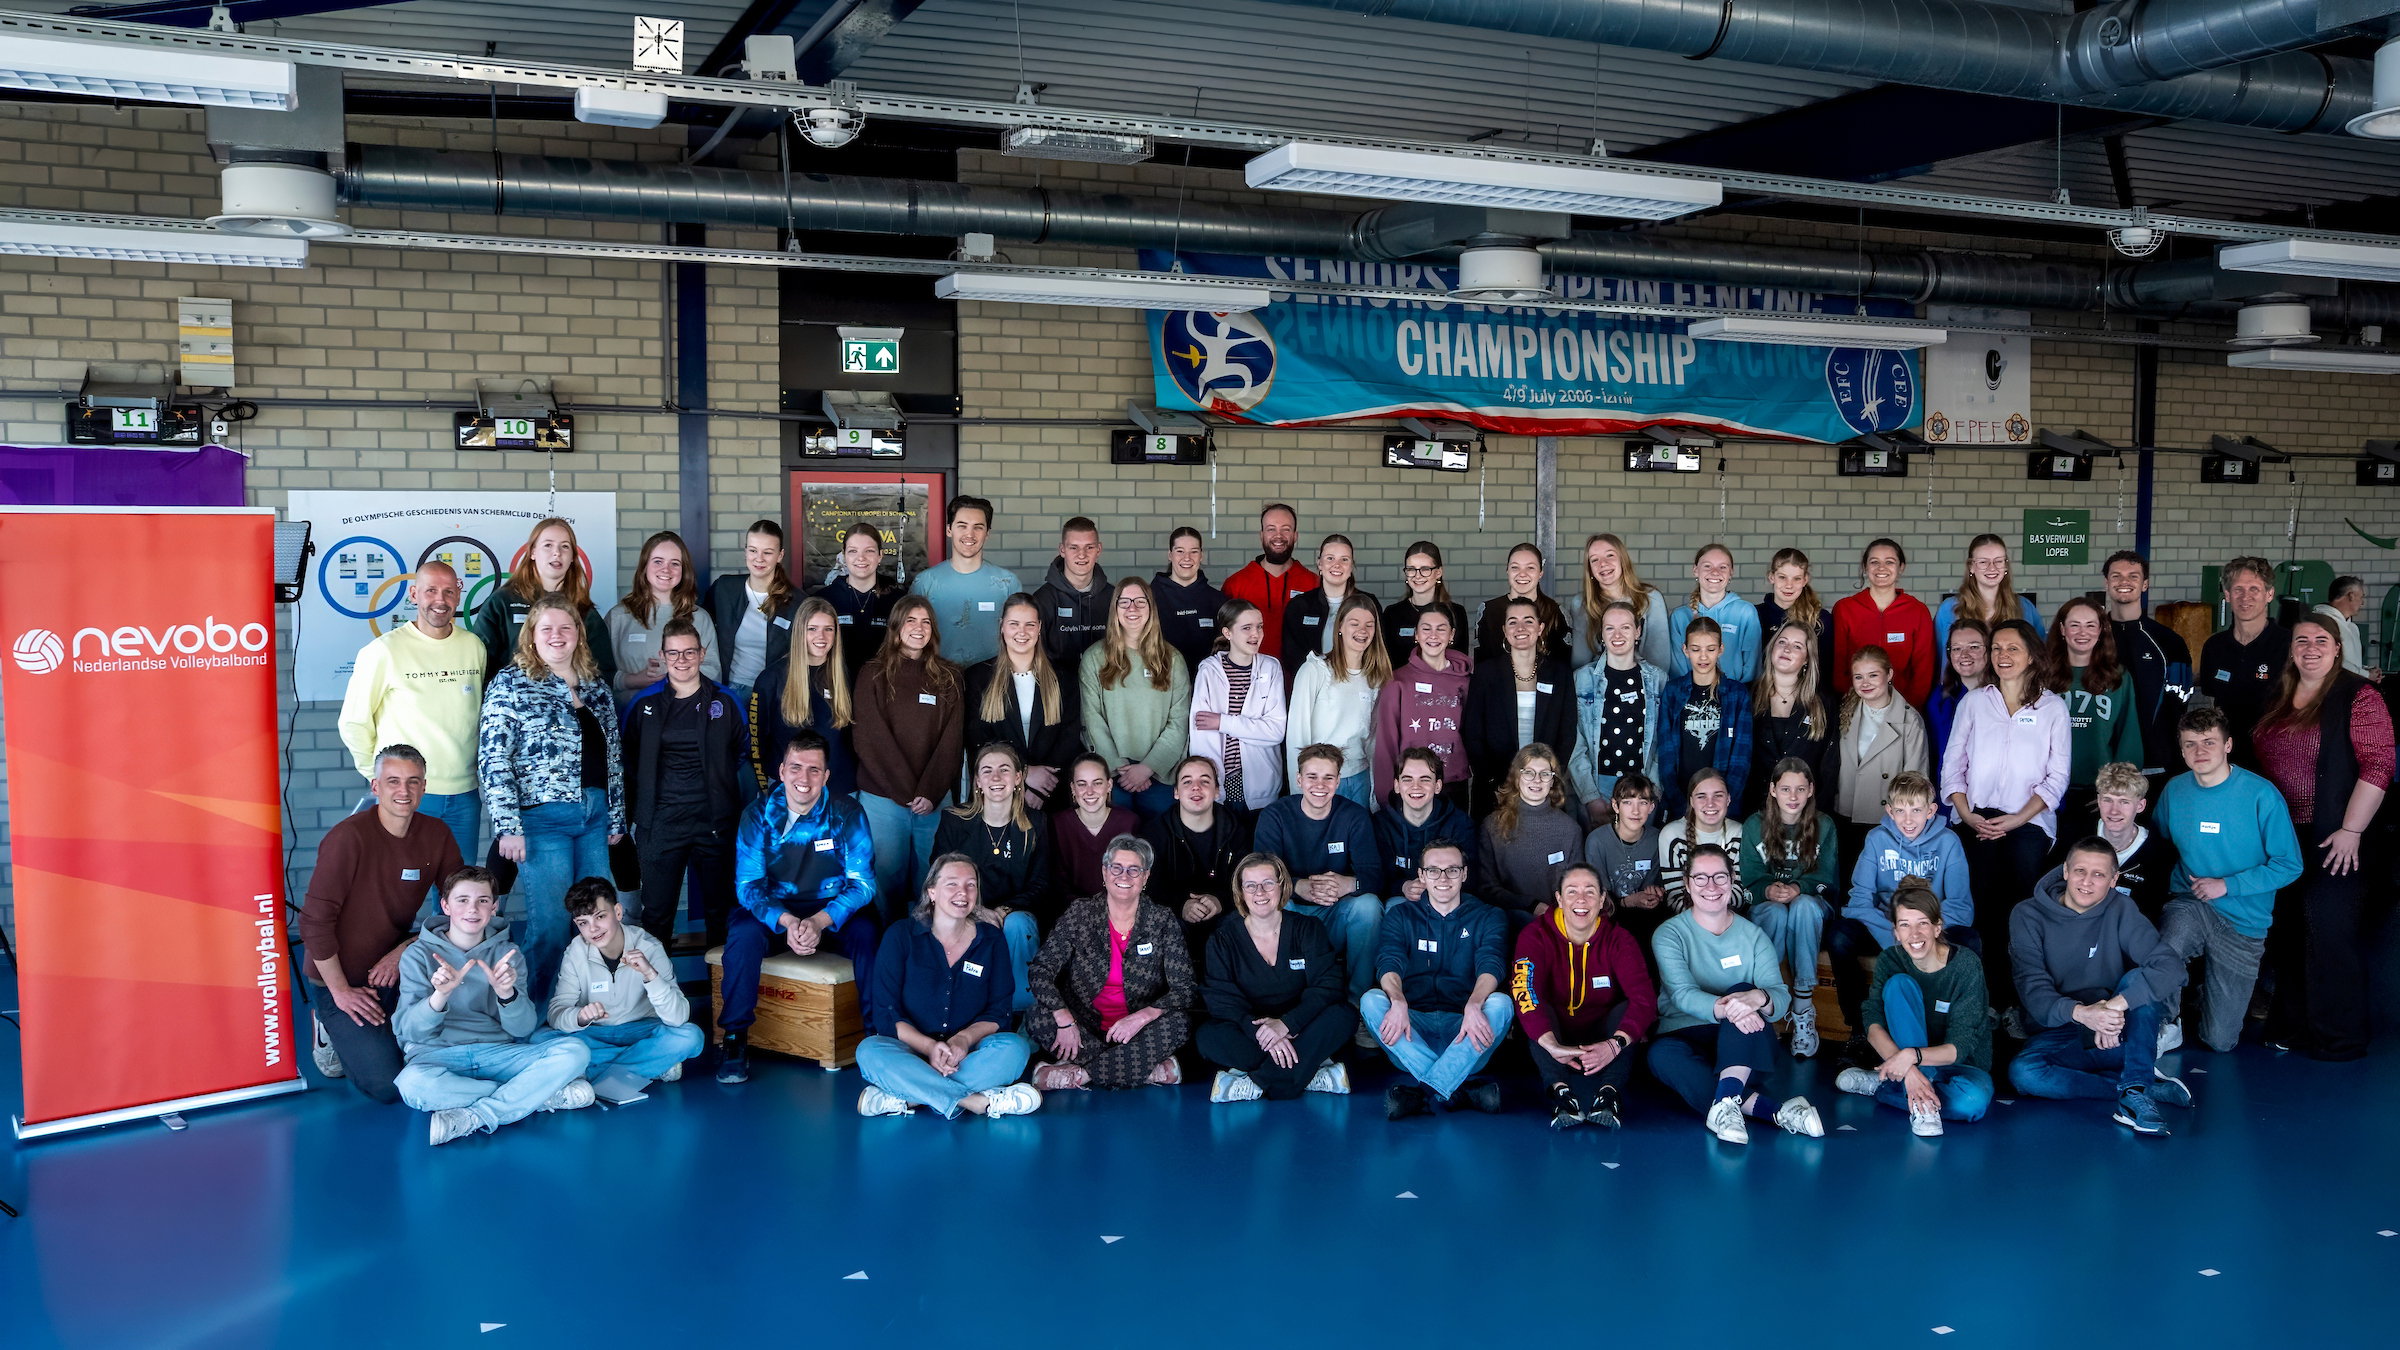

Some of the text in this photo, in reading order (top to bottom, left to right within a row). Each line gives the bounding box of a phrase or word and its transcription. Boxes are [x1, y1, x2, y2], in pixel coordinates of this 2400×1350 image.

[1396, 318, 1696, 386] CHAMPIONSHIP
[1833, 361, 1853, 404] EFC
[1529, 388, 1556, 406] July
[1559, 389, 1594, 403] 2006
[121, 411, 150, 428] 11
[503, 420, 529, 435] 10
[1955, 419, 2006, 443] EPEE
[848, 430, 860, 444] 9
[1155, 436, 1167, 450] 8
[1424, 443, 1434, 456] 7
[1660, 447, 1670, 460] 6
[1872, 453, 1881, 465] 5
[2059, 458, 2068, 470] 4
[2229, 462, 2237, 473] 3
[2382, 466, 2390, 476] 2
[354, 510, 404, 523] OLYMPISCHE
[405, 508, 461, 517] GESCHIEDENIS
[480, 508, 531, 519] SCHERMCLUB
[2029, 534, 2045, 544] BAS
[2045, 547, 2070, 557] LOPER
[72, 615, 269, 659] nevobo
[73, 652, 268, 673] Nederlandse Volleybalbond
[405, 671, 439, 679] TOMMY
[749, 691, 761, 759] HIDDEN
[253, 893, 281, 1067] www.volleybal.nl
